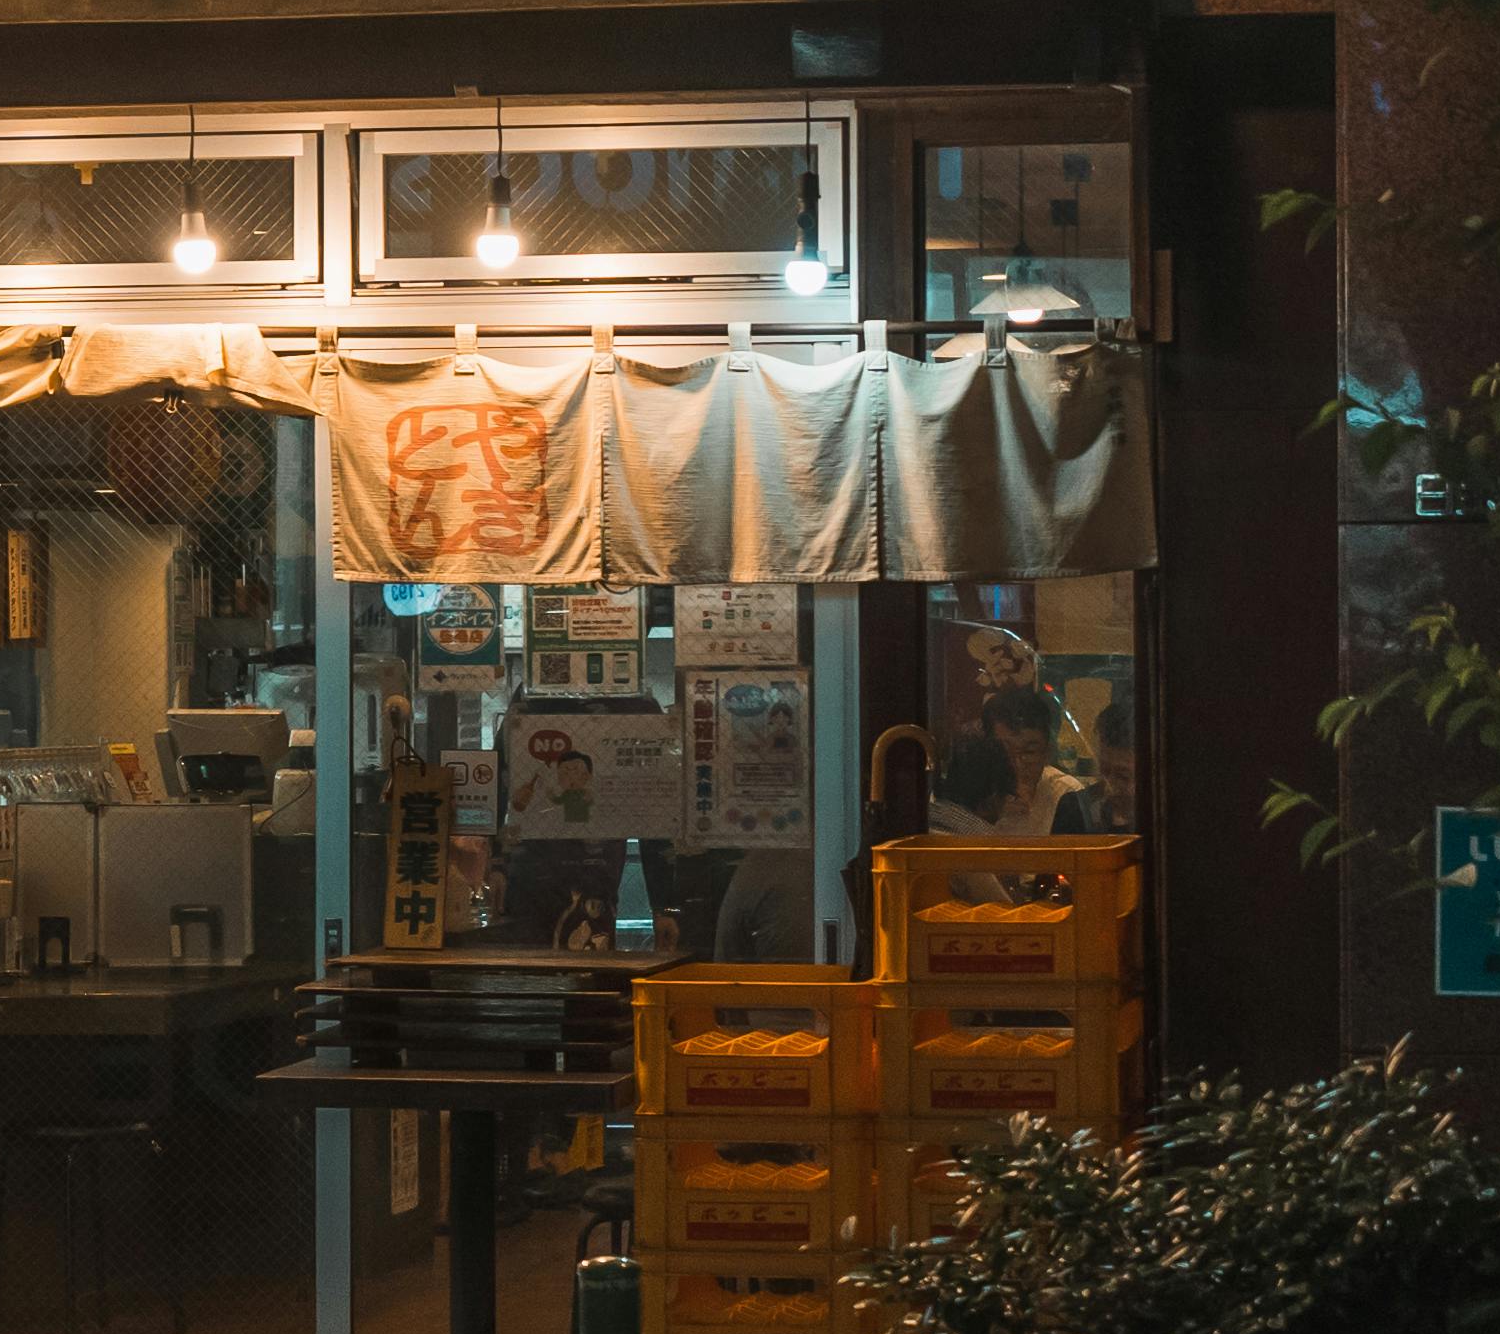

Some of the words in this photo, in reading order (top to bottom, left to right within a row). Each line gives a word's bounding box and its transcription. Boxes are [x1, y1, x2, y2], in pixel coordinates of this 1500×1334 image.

[388, 405, 548, 560] やきとん
[534, 737, 565, 753] NO
[395, 791, 443, 936] 営業中
[943, 937, 1042, 955] ホッピー
[699, 1071, 797, 1088] ホッピー
[945, 1073, 1043, 1089] ホッピー
[700, 1206, 797, 1222] ホッピー
